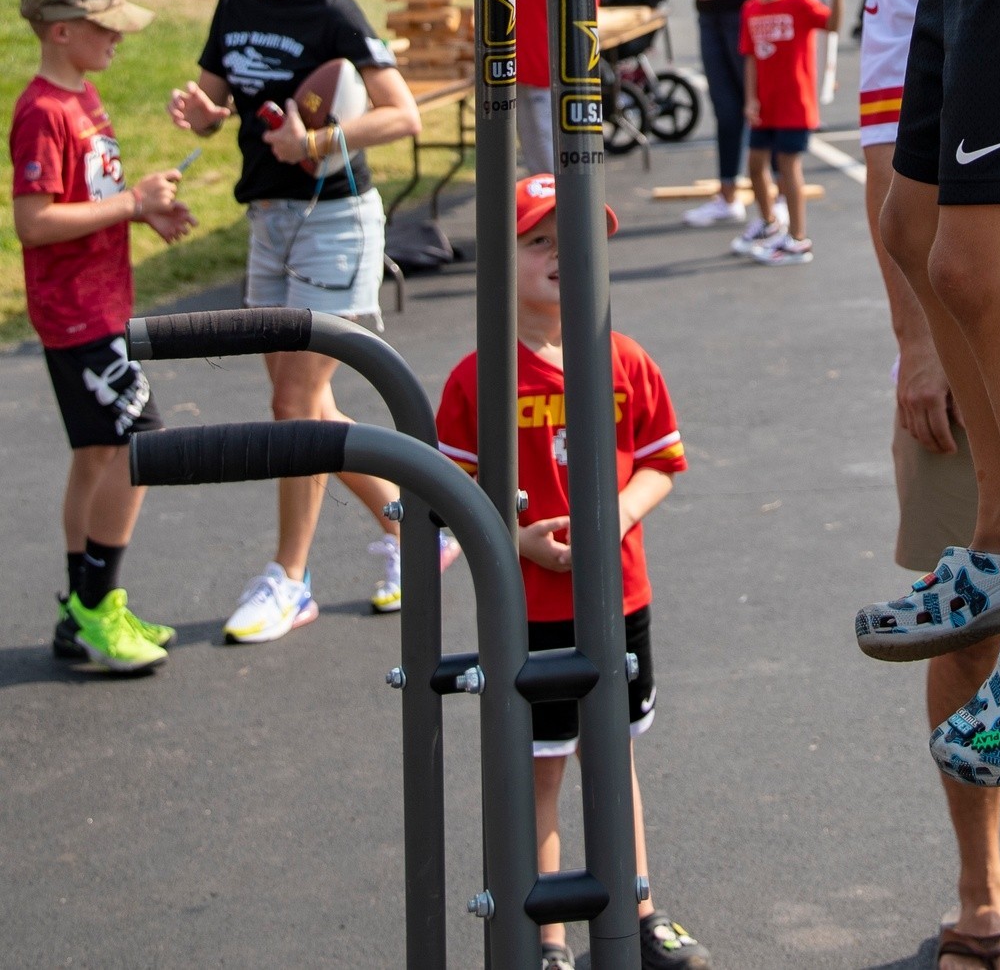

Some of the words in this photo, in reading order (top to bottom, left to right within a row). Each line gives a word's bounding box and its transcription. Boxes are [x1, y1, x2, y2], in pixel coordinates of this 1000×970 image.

[571, 102, 603, 123] U.S.
[957, 707, 979, 729] GAME
[975, 732, 1000, 745] PLAY
